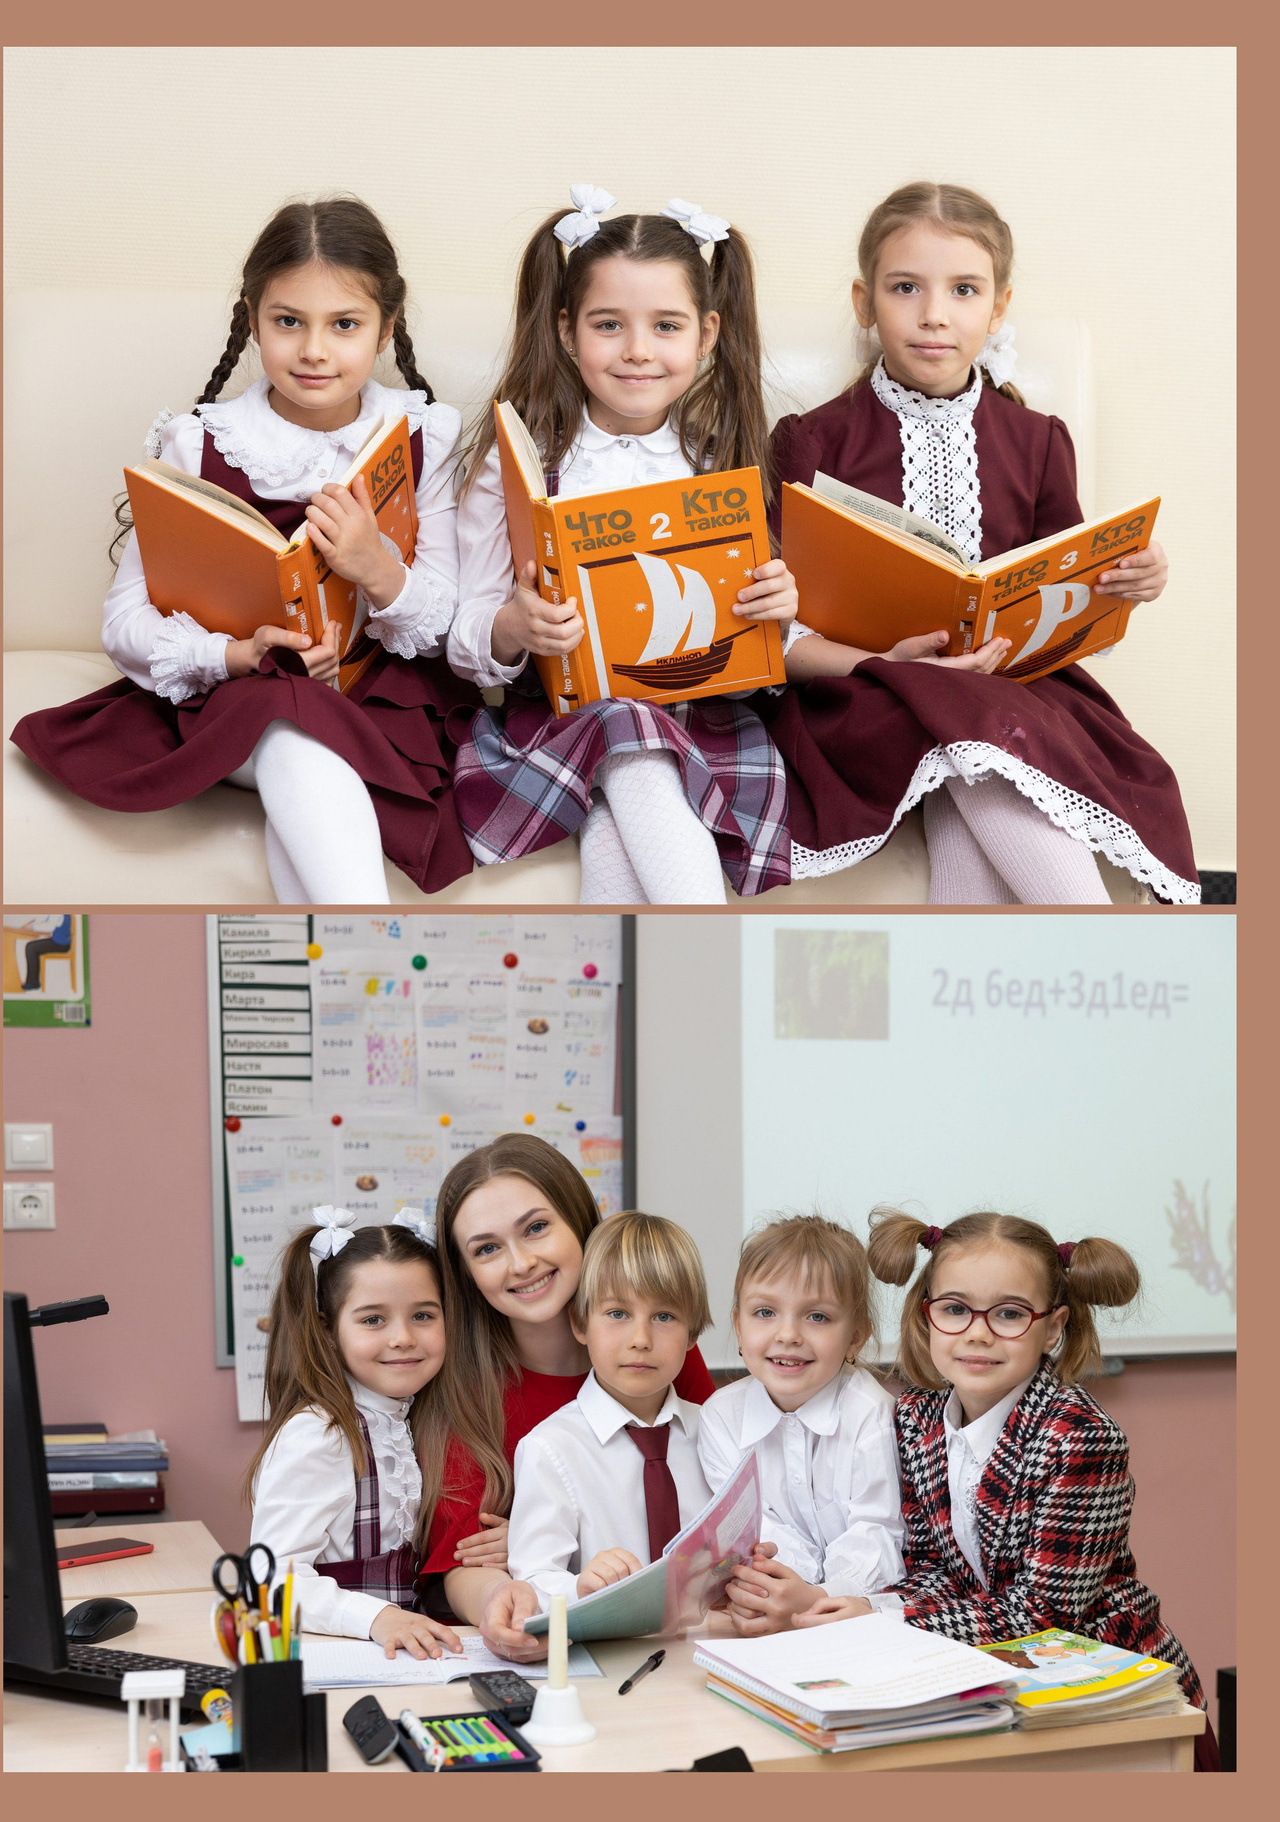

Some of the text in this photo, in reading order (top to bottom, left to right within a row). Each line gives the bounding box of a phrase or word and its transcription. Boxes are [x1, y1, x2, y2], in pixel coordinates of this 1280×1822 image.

[371, 443, 404, 492] Кто
[373, 460, 405, 503] такой
[681, 487, 747, 517] Кто
[564, 509, 633, 537] Что
[649, 512, 673, 540] 2
[685, 508, 751, 532] такой
[1090, 515, 1146, 549] Кто
[544, 531, 554, 556] Том 2
[571, 529, 637, 553] такое
[1089, 527, 1144, 558] такой
[1059, 550, 1079, 571] 3
[994, 559, 1049, 589] Что
[991, 572, 1047, 602] такое
[564, 677, 572, 693] Что
[222, 927, 270, 938] Камила
[223, 948, 271, 960] Кирилл
[225, 969, 256, 981] Кира
[225, 994, 265, 1007] Марта
[931, 967, 975, 1018] 2д
[226, 1038, 289, 1050] Мирослав
[227, 1061, 261, 1072] Настя
[228, 1083, 272, 1094] Платон
